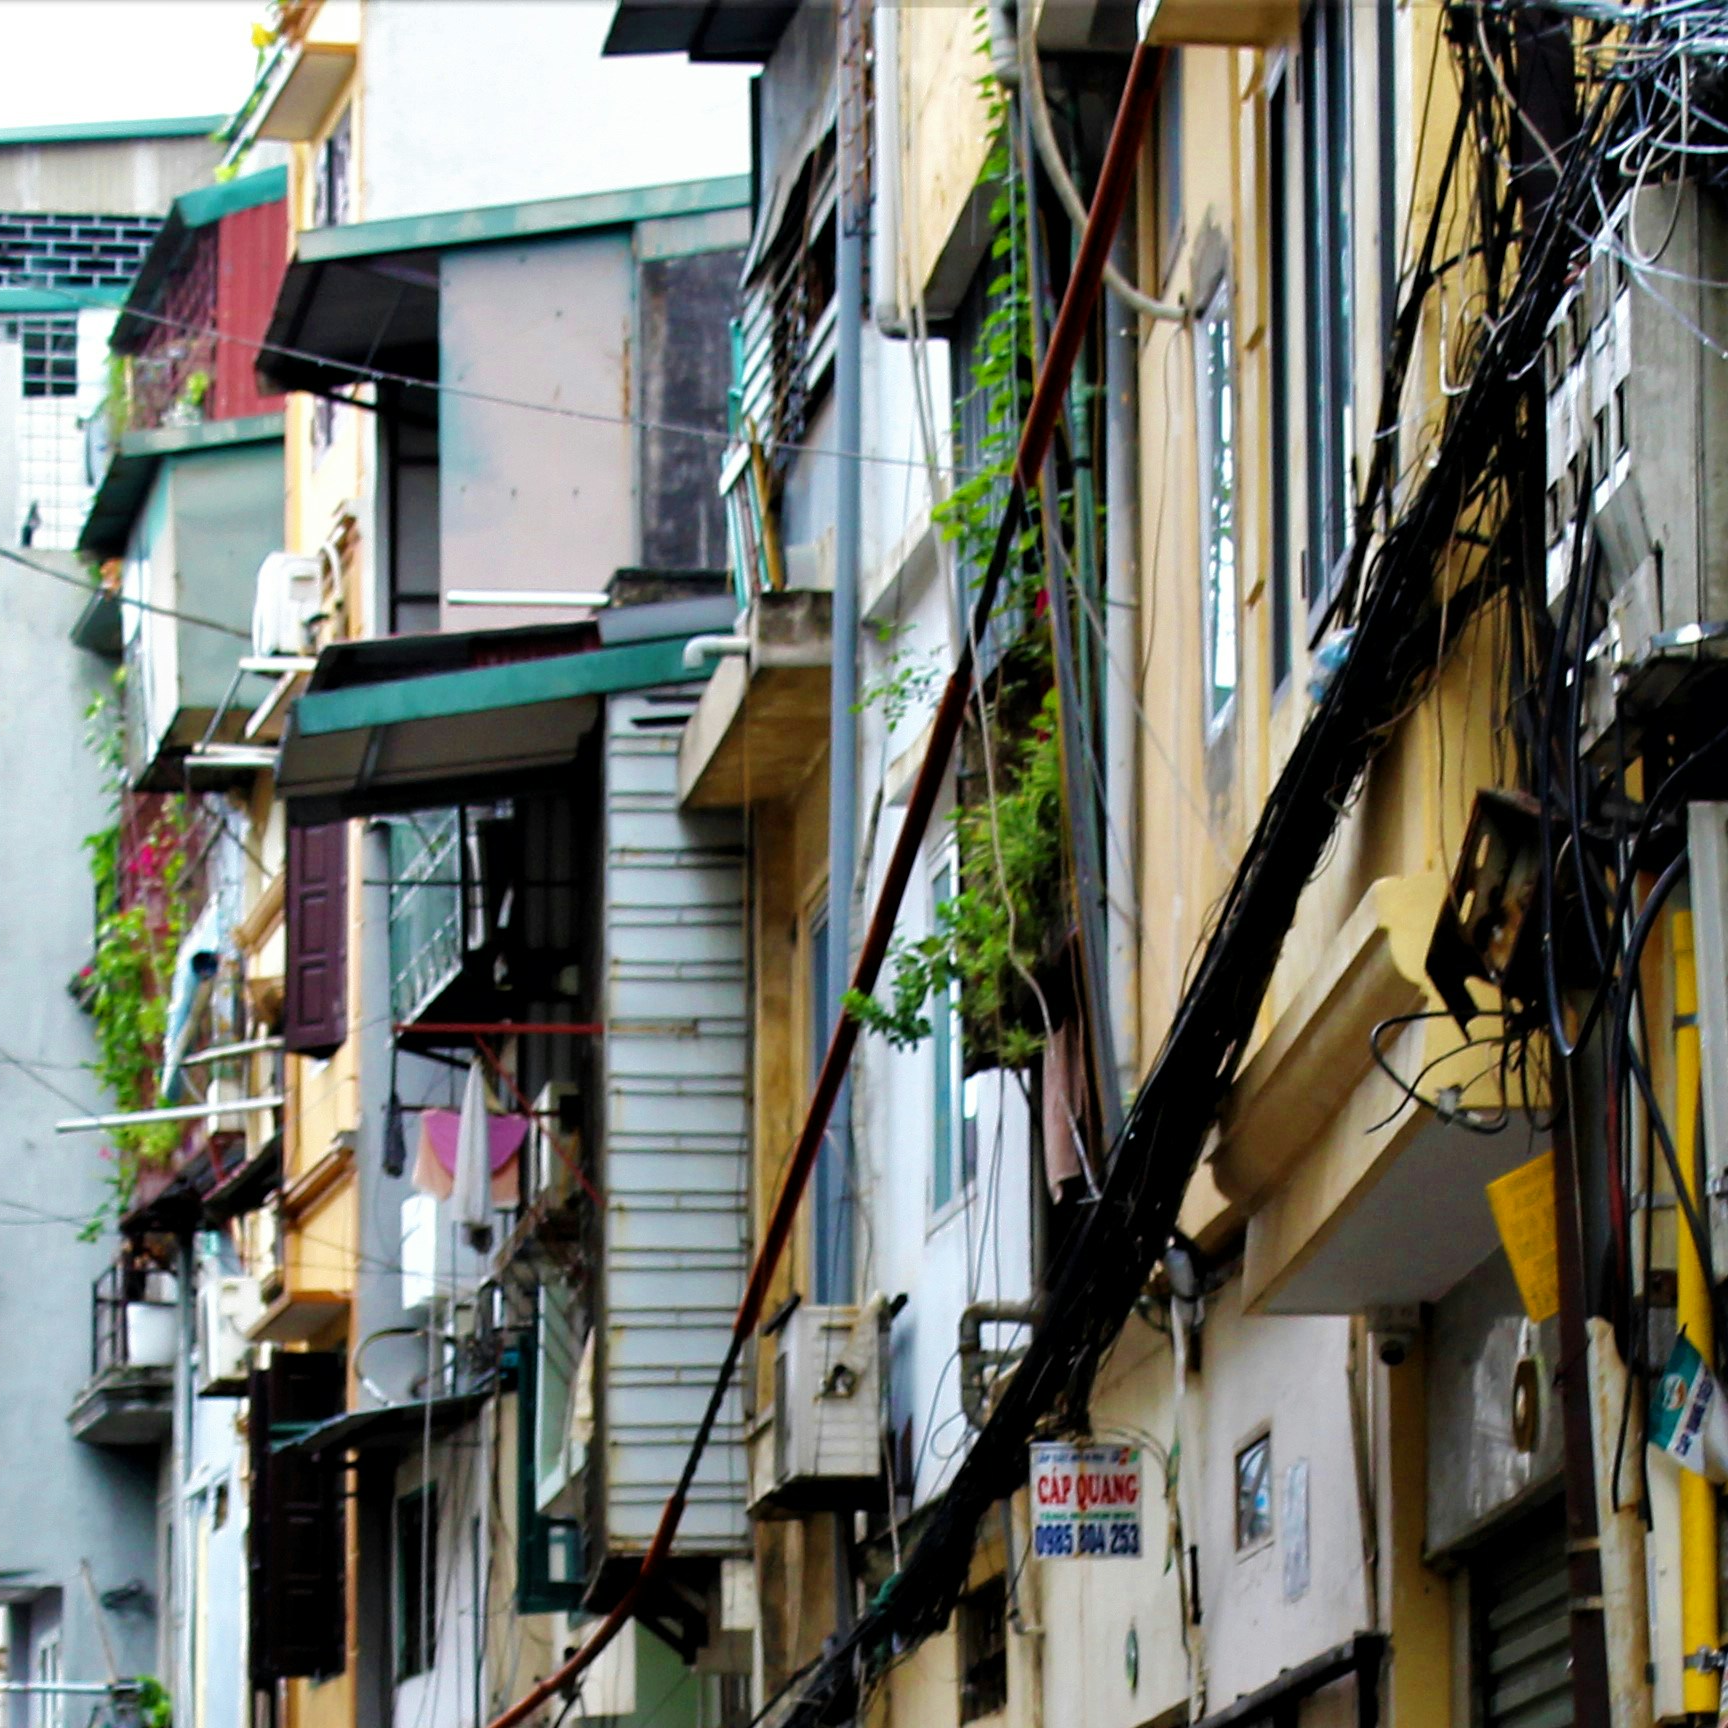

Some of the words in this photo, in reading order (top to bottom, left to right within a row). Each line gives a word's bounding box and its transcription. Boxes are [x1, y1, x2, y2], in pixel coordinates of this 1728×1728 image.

[1037, 1467, 1071, 1505] CÁP
[1076, 1474, 1140, 1512] QUANG
[1110, 1522, 1139, 1554] 253
